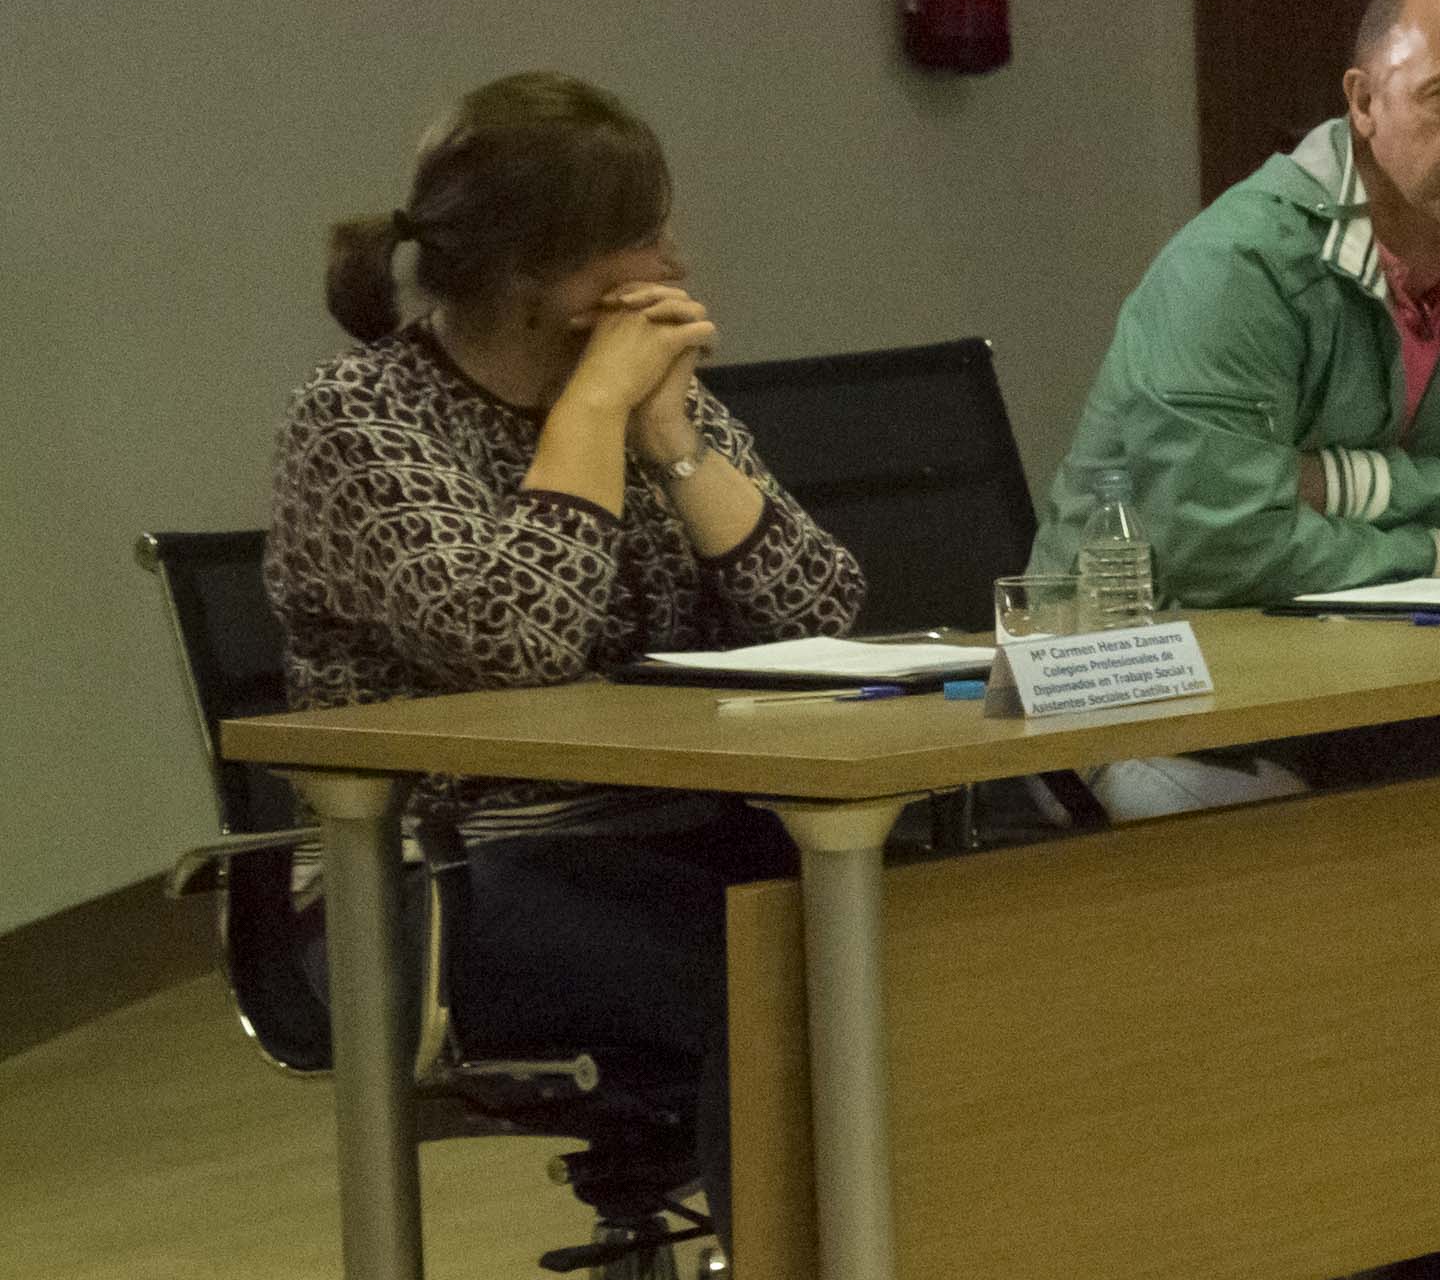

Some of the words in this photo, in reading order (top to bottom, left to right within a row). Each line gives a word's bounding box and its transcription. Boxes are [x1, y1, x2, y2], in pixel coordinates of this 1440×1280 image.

[1049, 645, 1096, 659] Carmen
[1097, 640, 1132, 652] Heras
[1132, 634, 1183, 648] Zamarro
[1043, 664, 1089, 678] Colegios
[1089, 654, 1160, 670] Profesionales
[1161, 651, 1174, 661] de
[1098, 677, 1111, 686] en
[1112, 671, 1153, 684] Trabajo
[1154, 665, 1186, 679] Social
[1187, 666, 1194, 675] y
[1032, 698, 1087, 714] Asistentes
[1088, 691, 1131, 705] Sociales
[1132, 684, 1171, 699] Castilla
[1172, 685, 1180, 694] y
